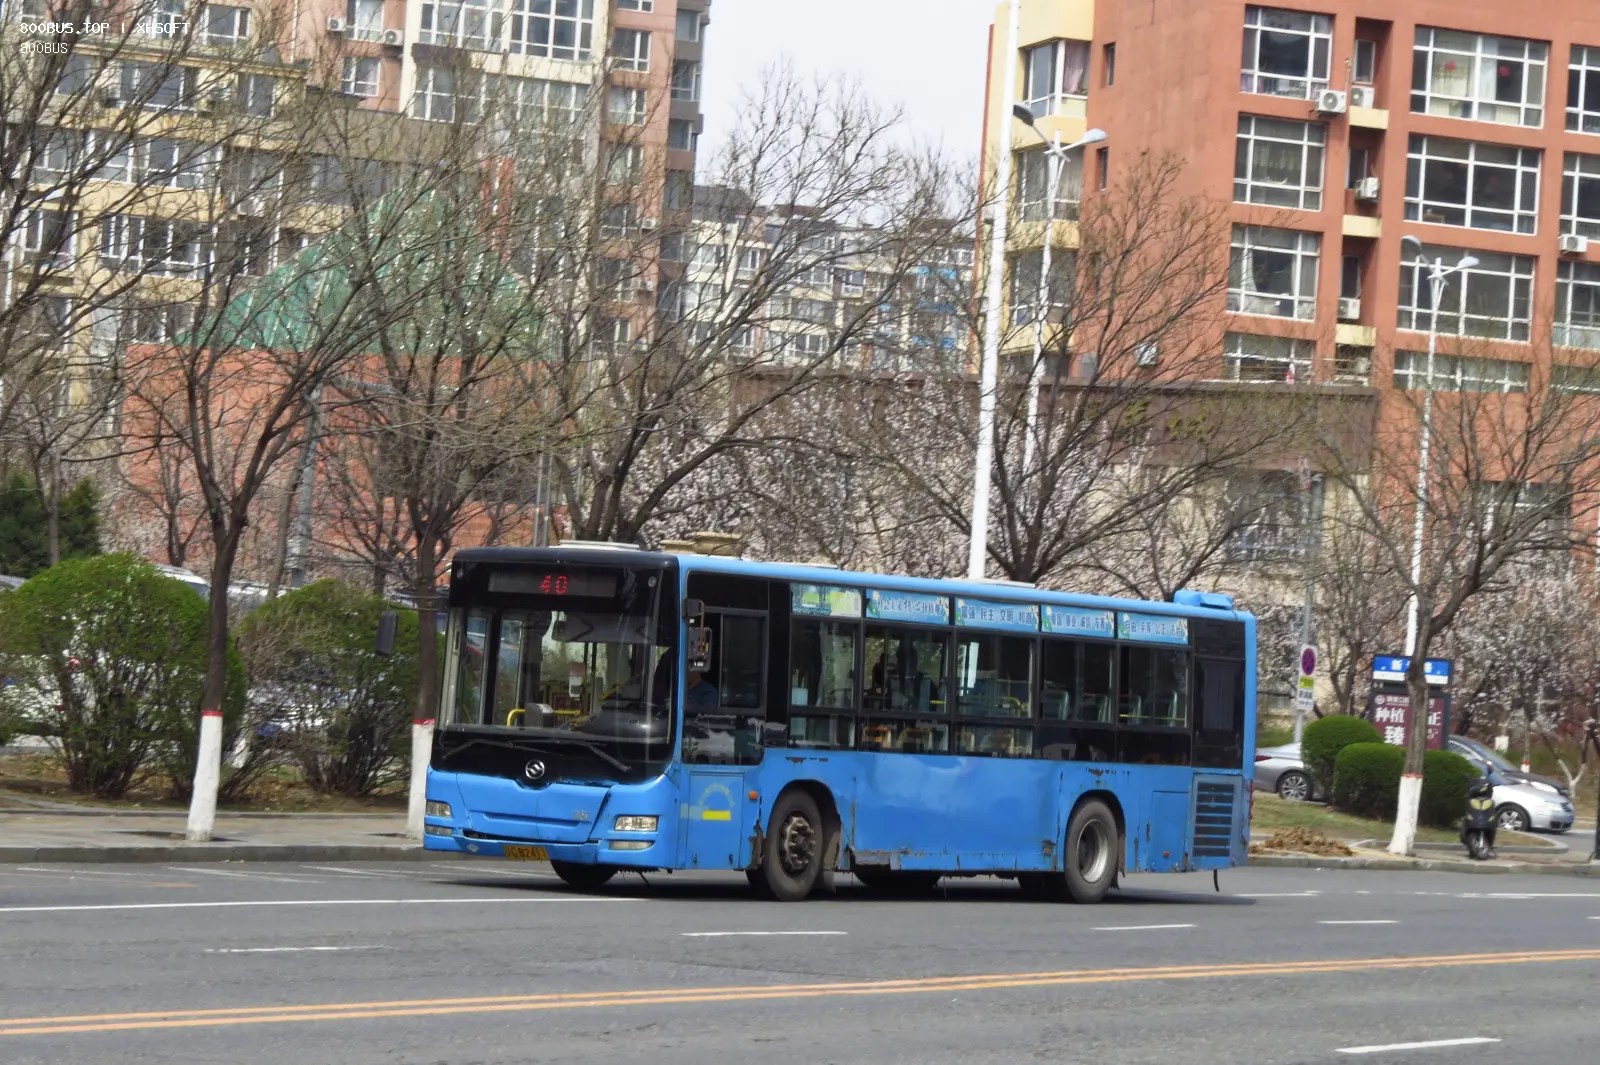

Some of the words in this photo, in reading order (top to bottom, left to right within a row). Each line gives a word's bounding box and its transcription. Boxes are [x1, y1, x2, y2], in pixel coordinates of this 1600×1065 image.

[540, 575, 568, 594] 40
[980, 608, 994, 621] 民主
[1000, 609, 1014, 622] 文明
